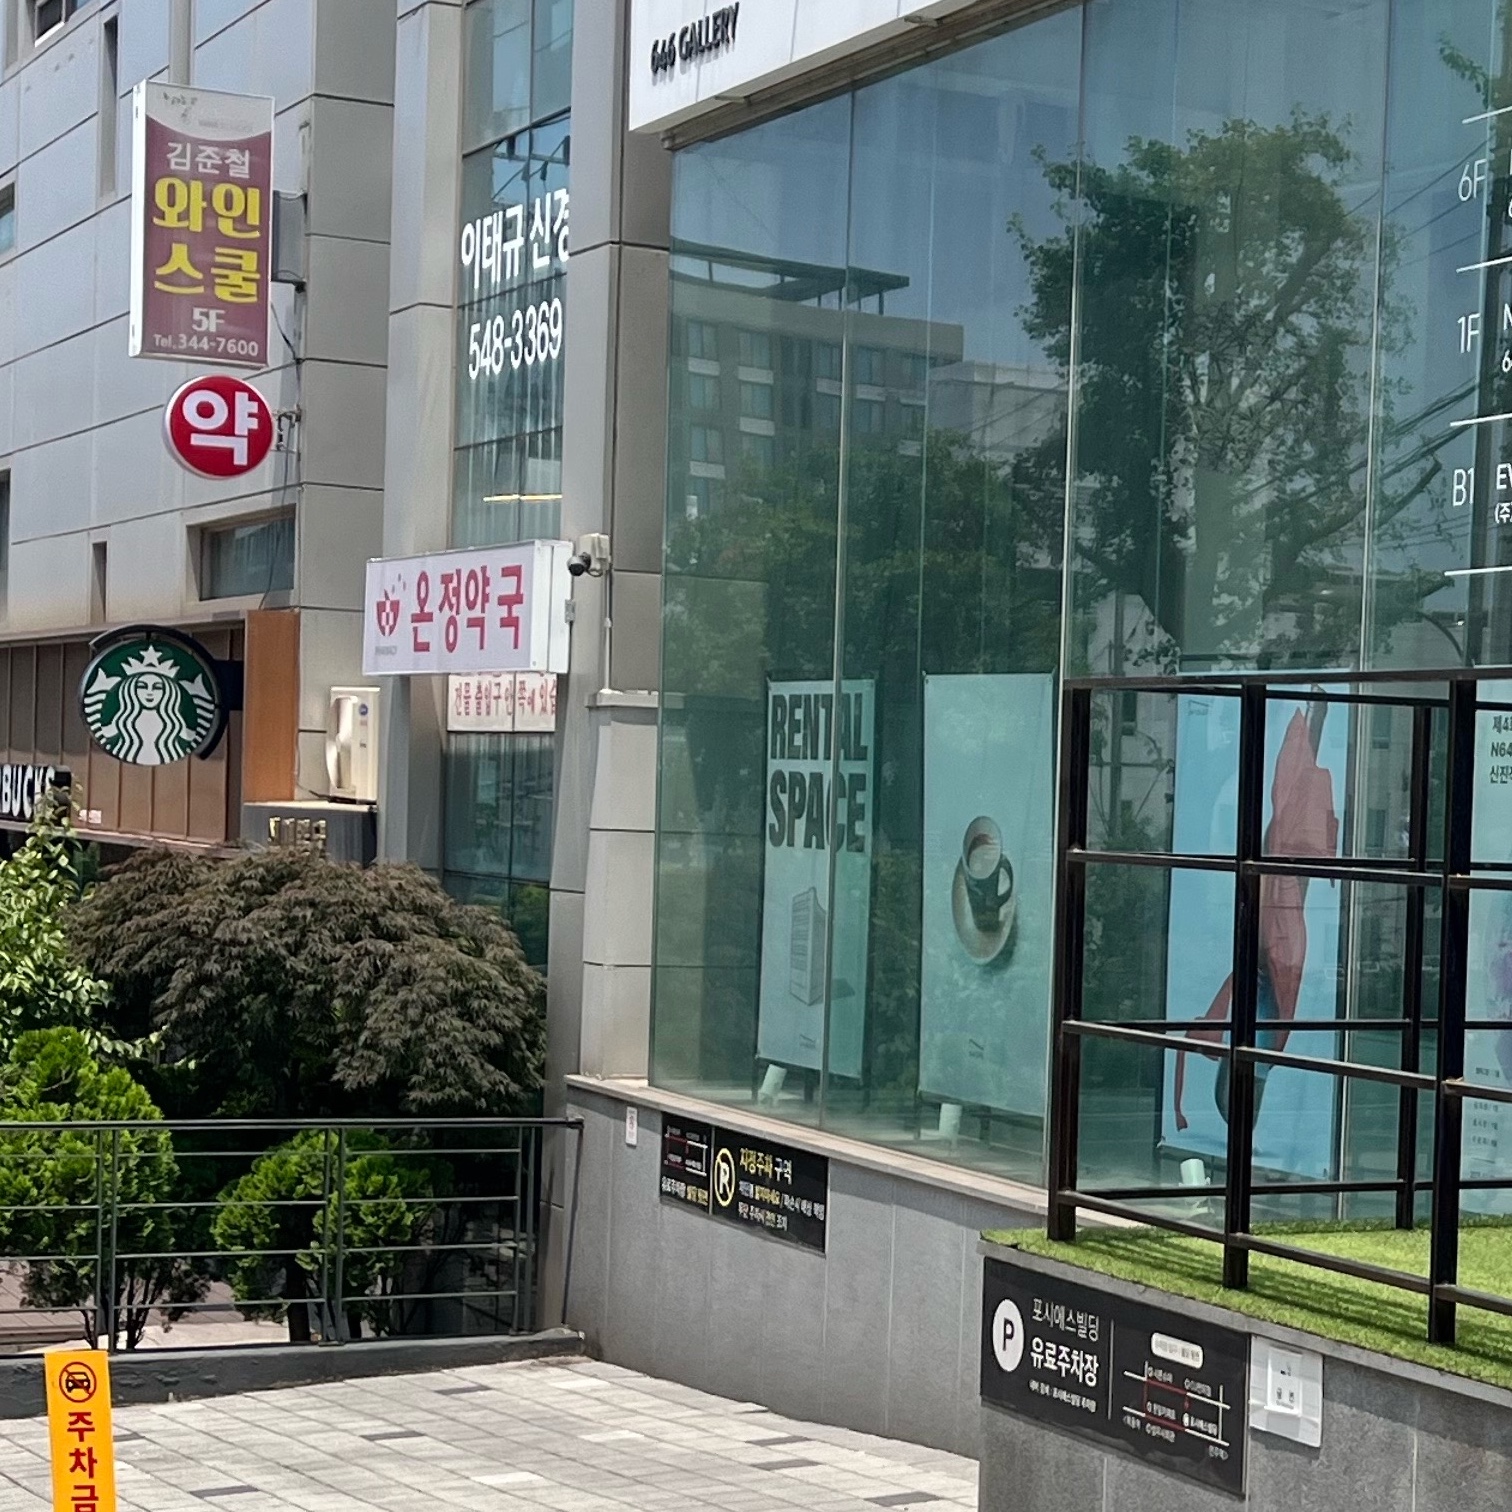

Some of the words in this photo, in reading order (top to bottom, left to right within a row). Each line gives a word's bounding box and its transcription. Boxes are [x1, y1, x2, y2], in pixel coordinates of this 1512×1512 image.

[650, 39, 676, 74] 646
[679, 1, 740, 61] GALLERY
[166, 142, 250, 179] 김준철
[1458, 159, 1487, 202] 6F
[153, 177, 261, 239] 와인
[154, 243, 261, 303] 스쿨
[461, 204, 525, 290] 이태규
[192, 307, 226, 332] 5F
[469, 298, 563, 380] 548-3369
[1457, 313, 1481, 353] 1F
[182, 389, 259, 466] 약
[1453, 467, 1475, 507] B1
[410, 564, 524, 654] 온정약국
[771, 692, 869, 762] RENTAL
[769, 768, 867, 854] SPACE
[1003, 1317, 1016, 1352] P
[1031, 1298, 1100, 1342] 포시에스빌딩
[1030, 1336, 1100, 1388] 유료주차장
